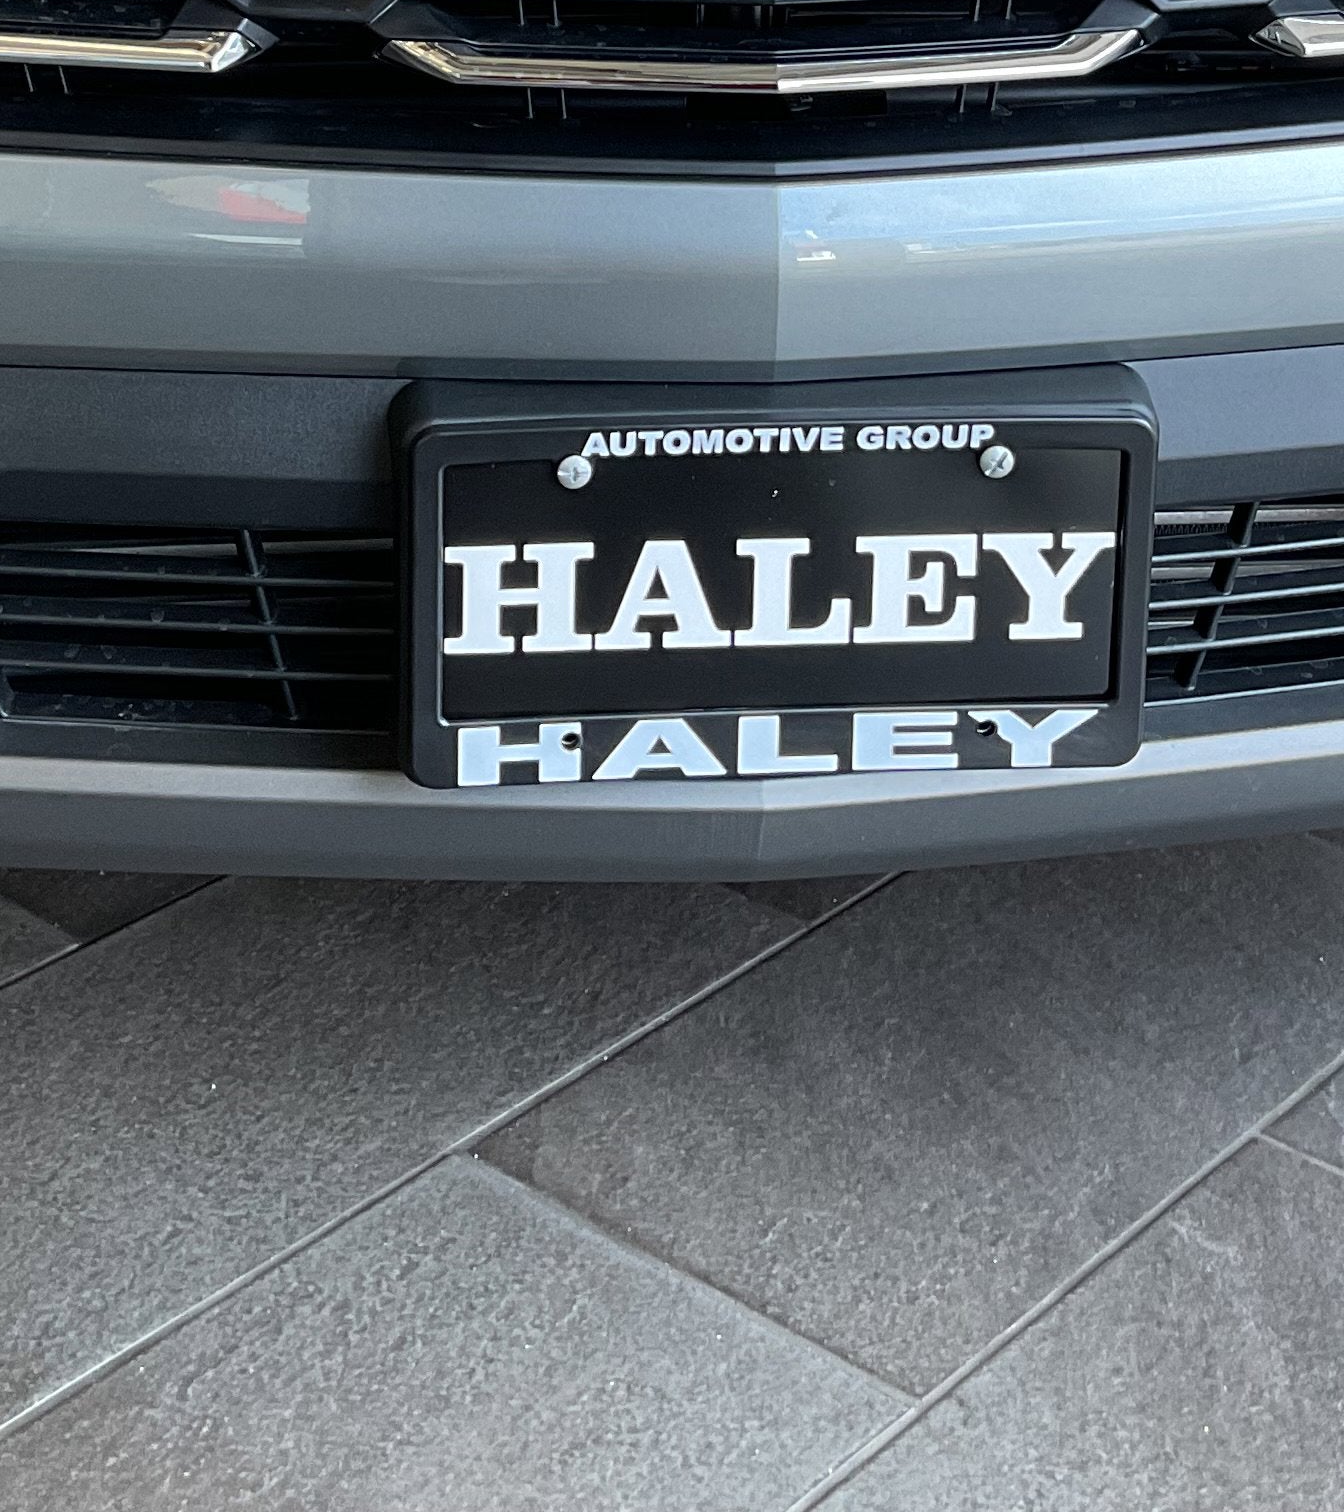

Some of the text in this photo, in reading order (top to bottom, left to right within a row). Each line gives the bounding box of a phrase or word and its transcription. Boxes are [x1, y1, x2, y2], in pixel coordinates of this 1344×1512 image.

[581, 423, 996, 458] AUTOMOTIVE GROUP
[444, 530, 1116, 654] HALEY
[457, 708, 1099, 788] HALEY
